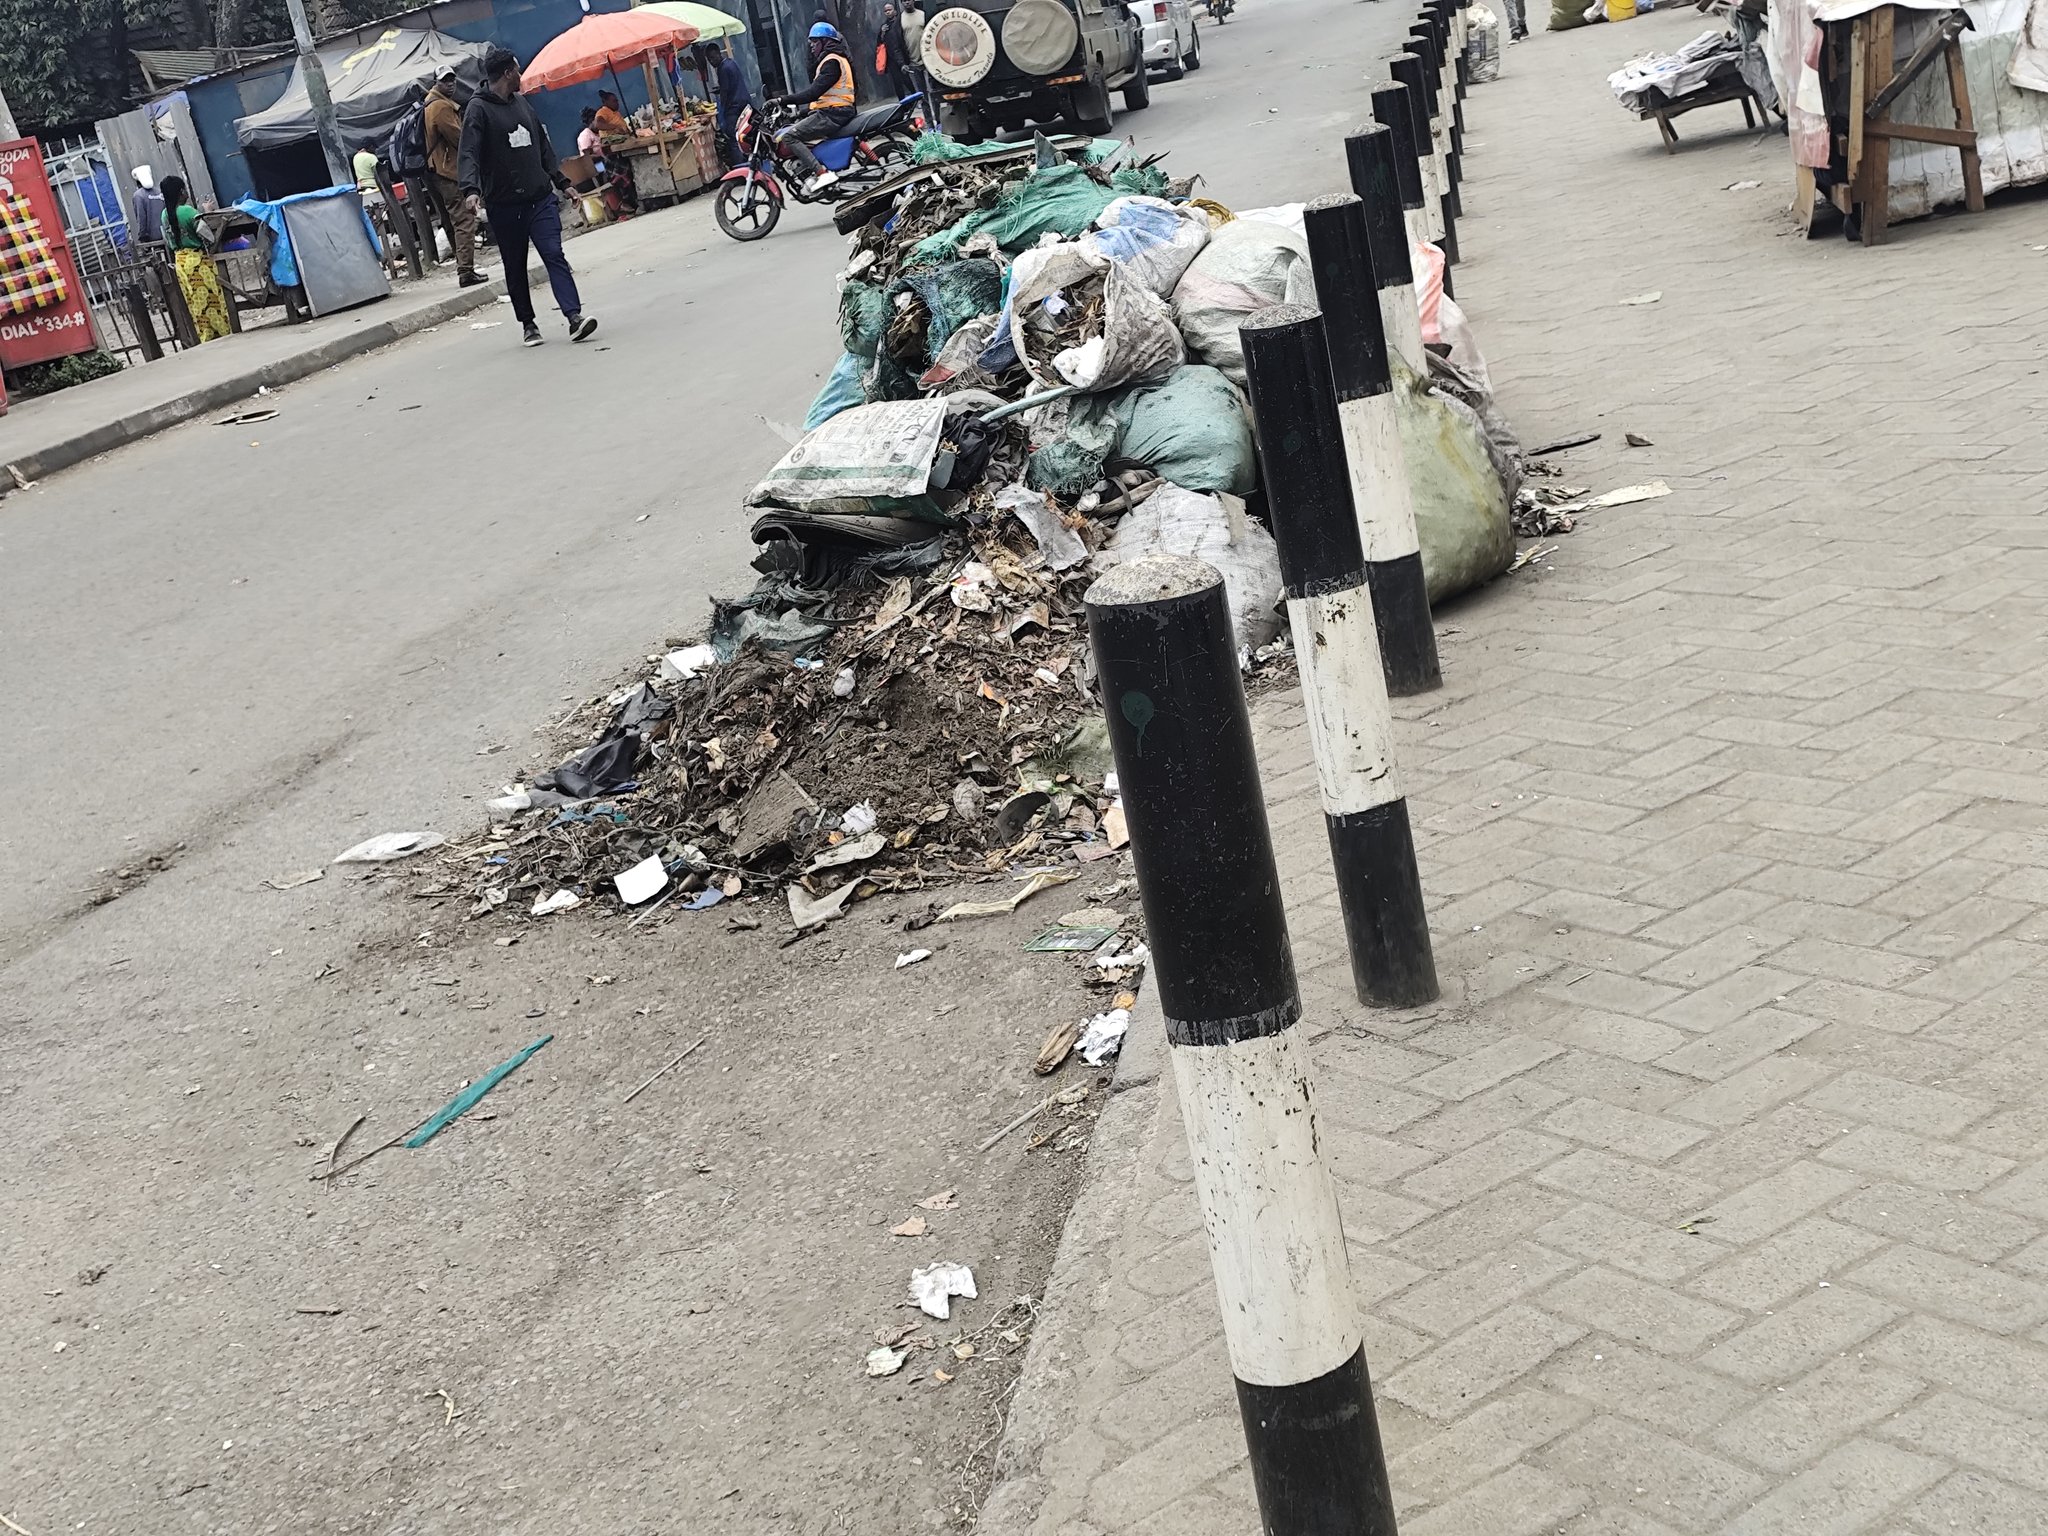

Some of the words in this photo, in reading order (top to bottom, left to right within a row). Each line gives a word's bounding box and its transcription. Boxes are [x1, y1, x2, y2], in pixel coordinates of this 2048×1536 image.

[925, 21, 939, 52] KESHE
[941, 11, 987, 34] WILDLIFE
[957, 77, 972, 85] and
[973, 52, 993, 77] Travels
